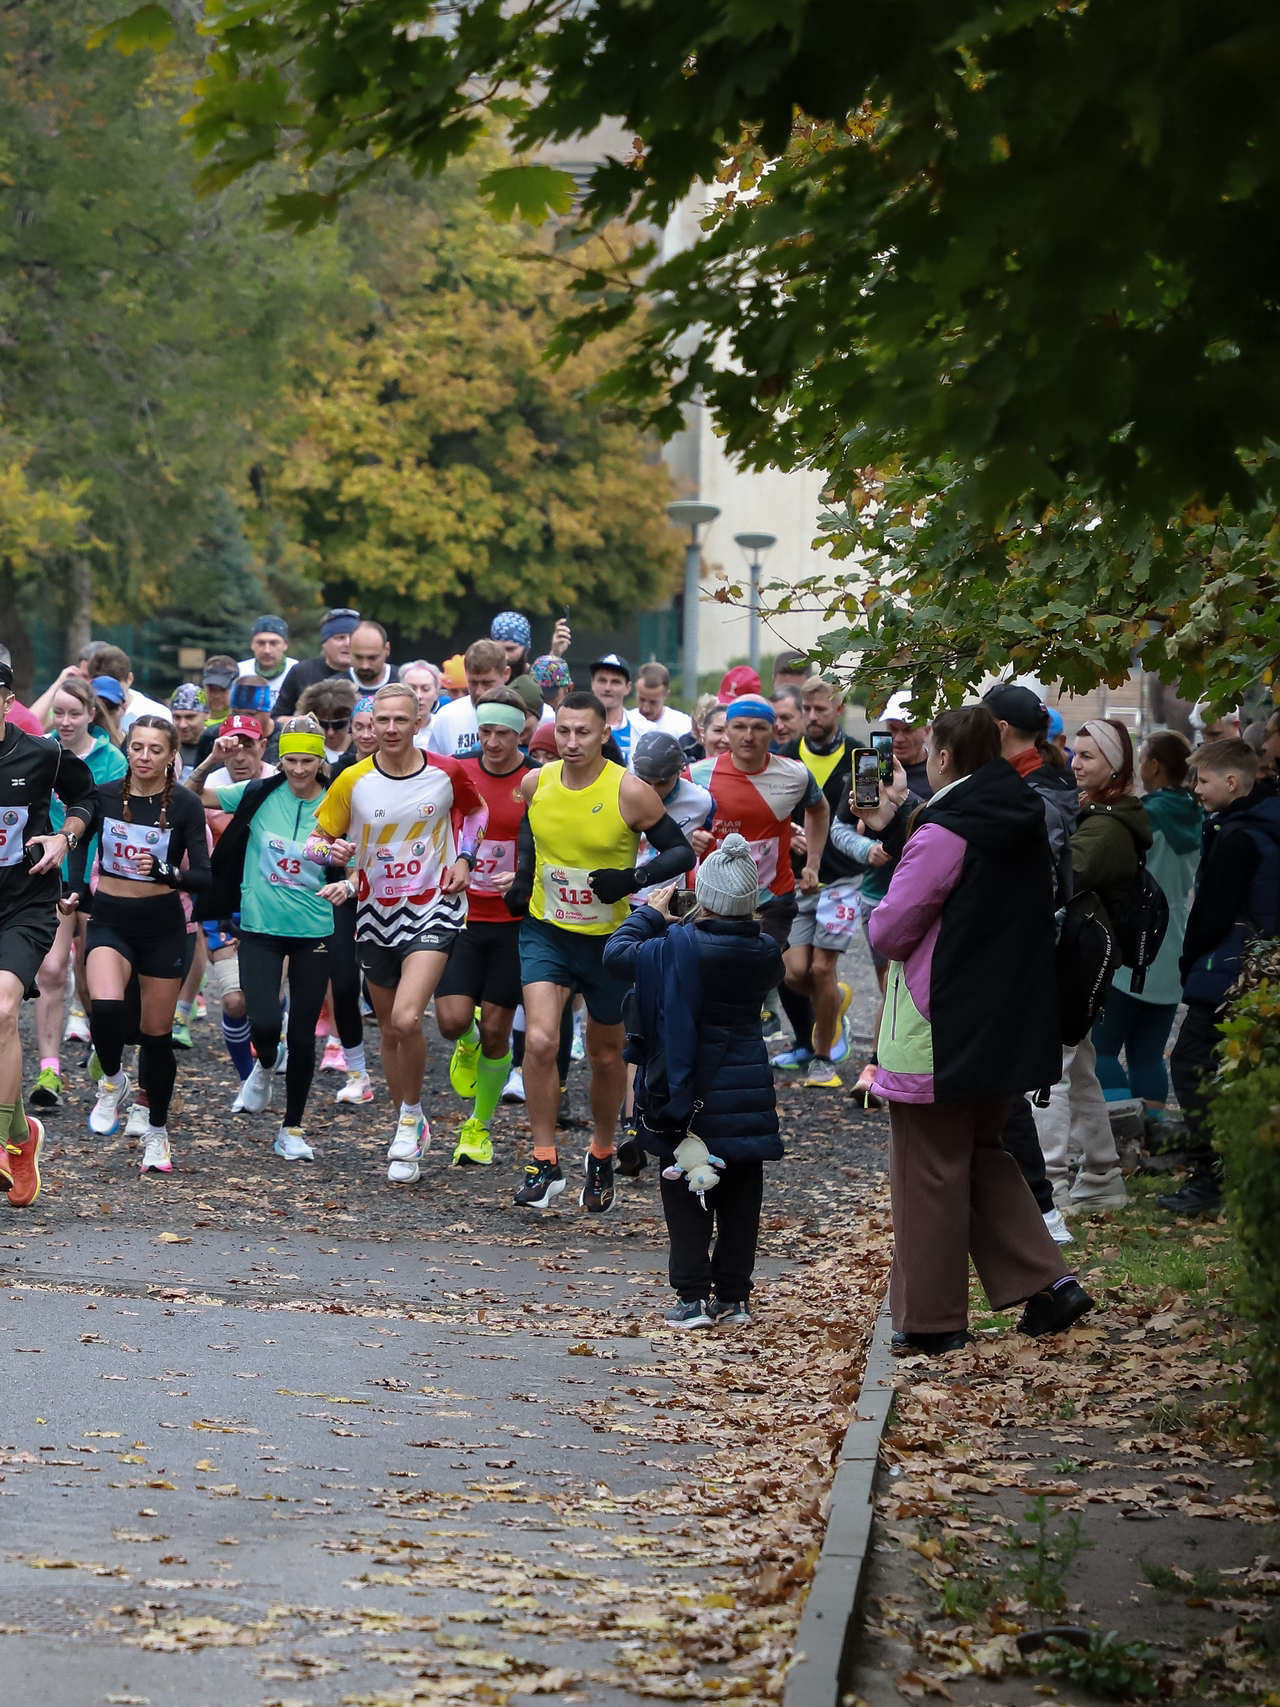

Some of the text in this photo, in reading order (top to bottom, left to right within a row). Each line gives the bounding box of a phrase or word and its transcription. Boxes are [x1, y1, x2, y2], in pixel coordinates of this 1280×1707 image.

[457, 732, 480, 748] #ЗА
[277, 858, 301, 875] 43
[384, 859, 421, 879] 120
[559, 887, 593, 905] 113
[835, 906, 855, 921] 33
